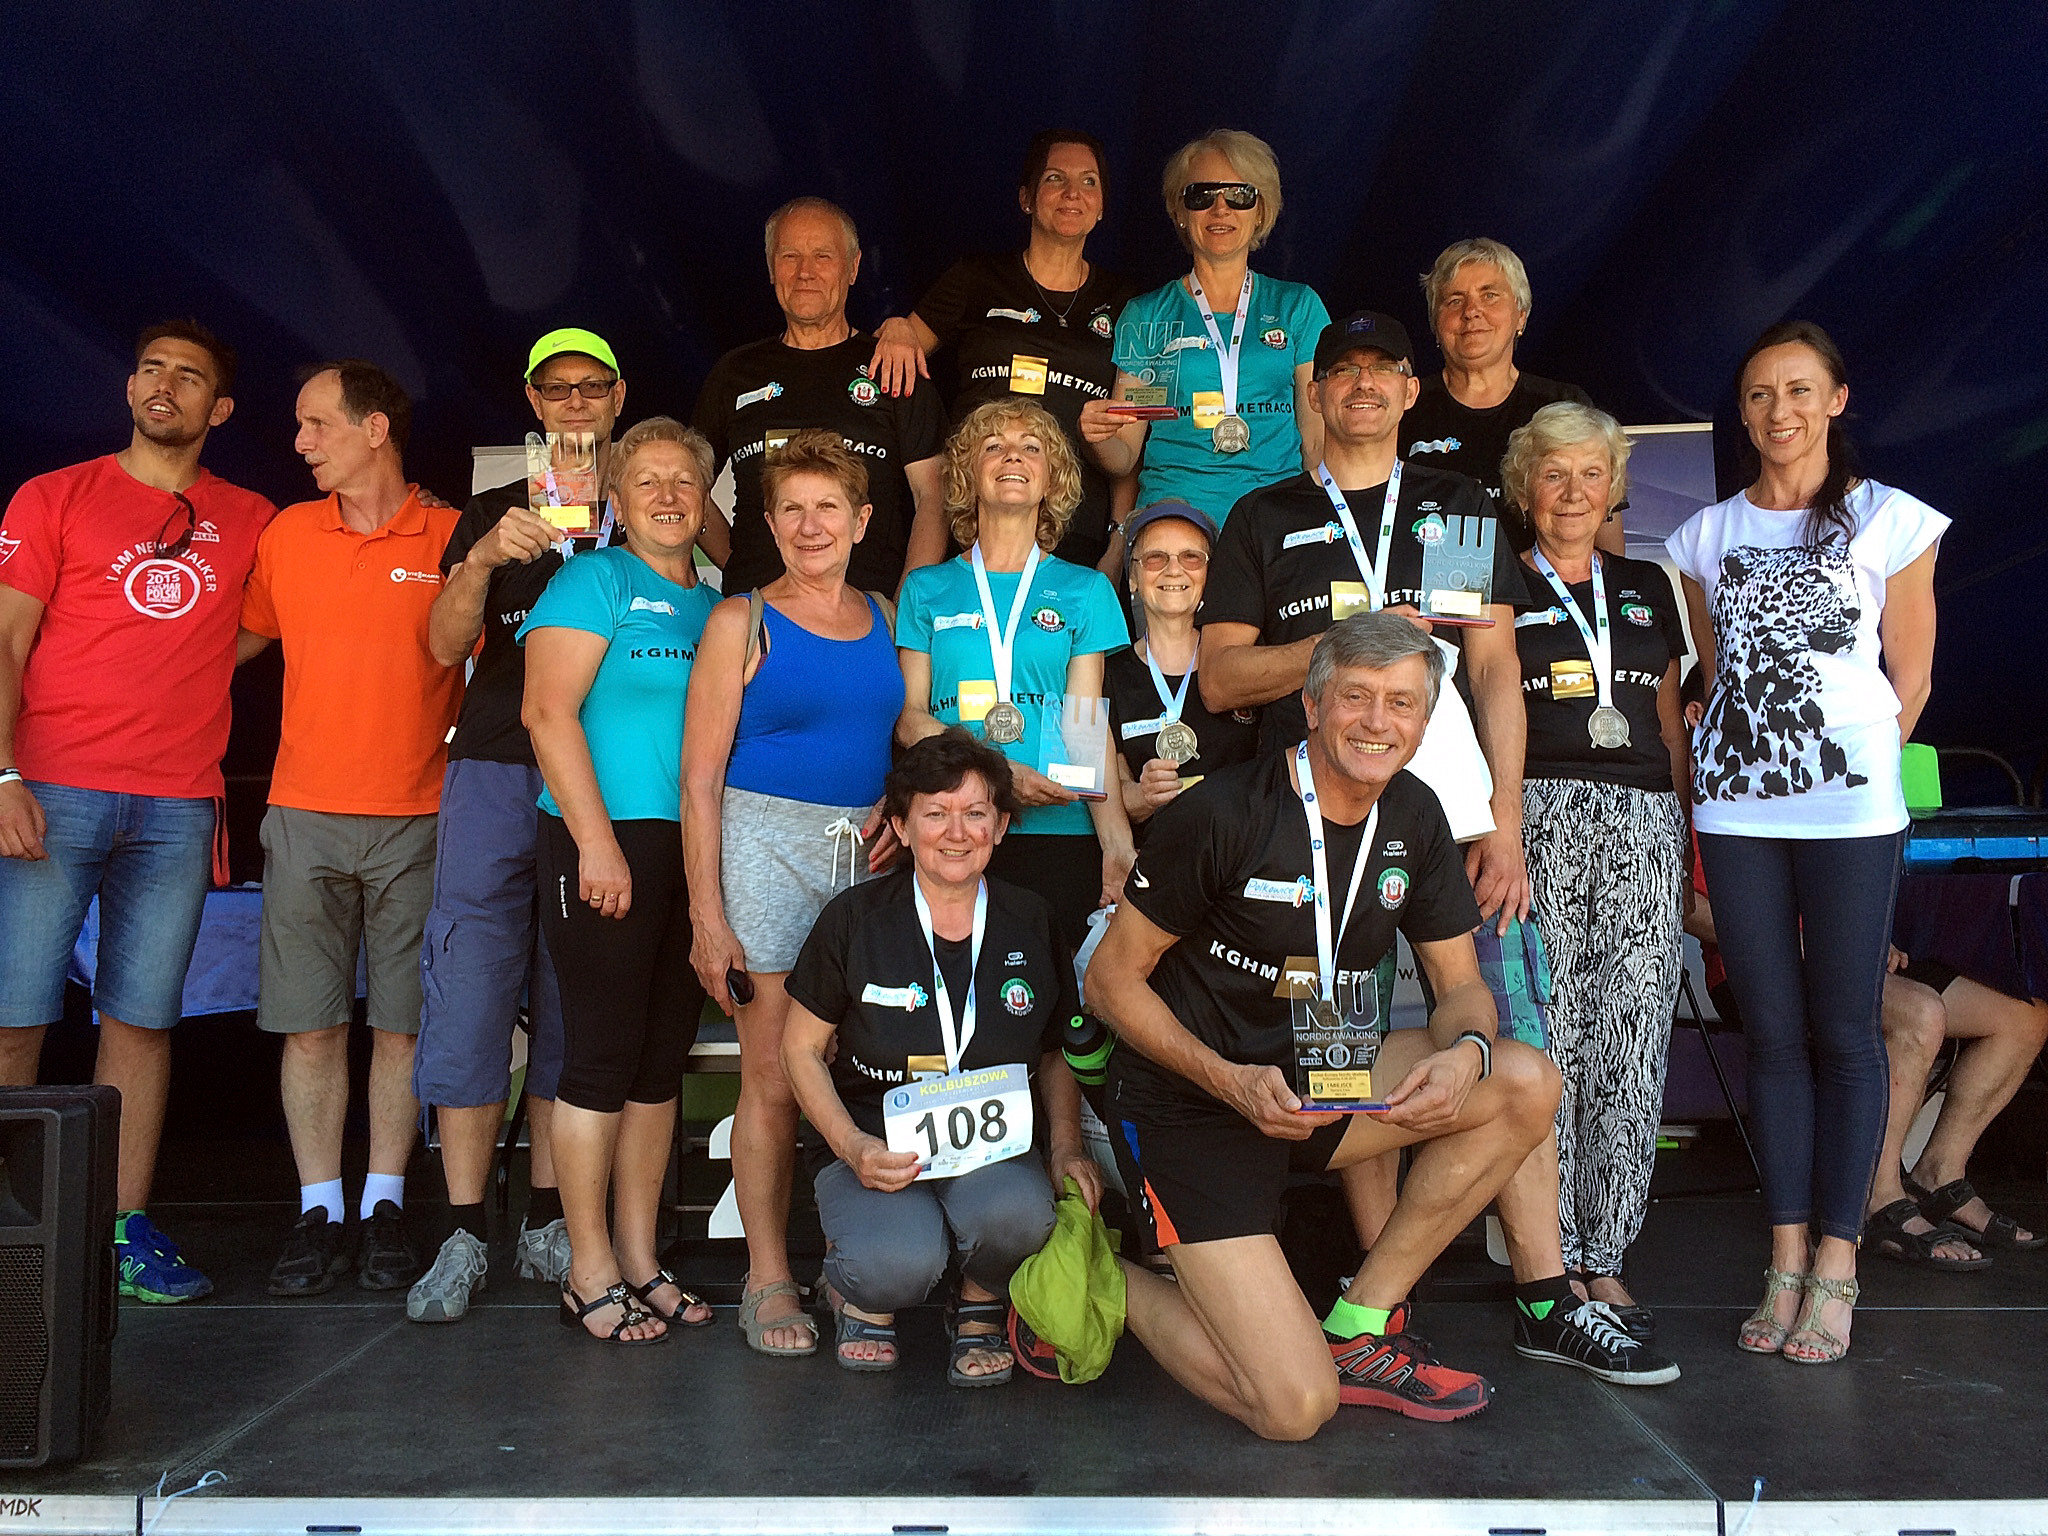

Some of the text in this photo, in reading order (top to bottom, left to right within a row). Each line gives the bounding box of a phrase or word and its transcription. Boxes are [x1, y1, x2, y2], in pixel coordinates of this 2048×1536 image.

[971, 365, 1010, 380] KGHM
[843, 438, 887, 459] RACO
[111, 549, 135, 575] AM
[181, 548, 217, 592] ALKER
[146, 573, 180, 585] 2015
[146, 589, 181, 600] POLSKI
[1278, 594, 1329, 621] KGHM
[501, 609, 531, 625] KGH
[630, 648, 695, 662] KGHM
[1521, 676, 1549, 692] HM
[1209, 940, 1279, 982] KGHM
[1296, 1031, 1378, 1041] NORDIC WALKING
[920, 1070, 1009, 1096] KOLBUSZOWA
[915, 1099, 1008, 1157] 108
[0, 1497, 43, 1517] MDK
